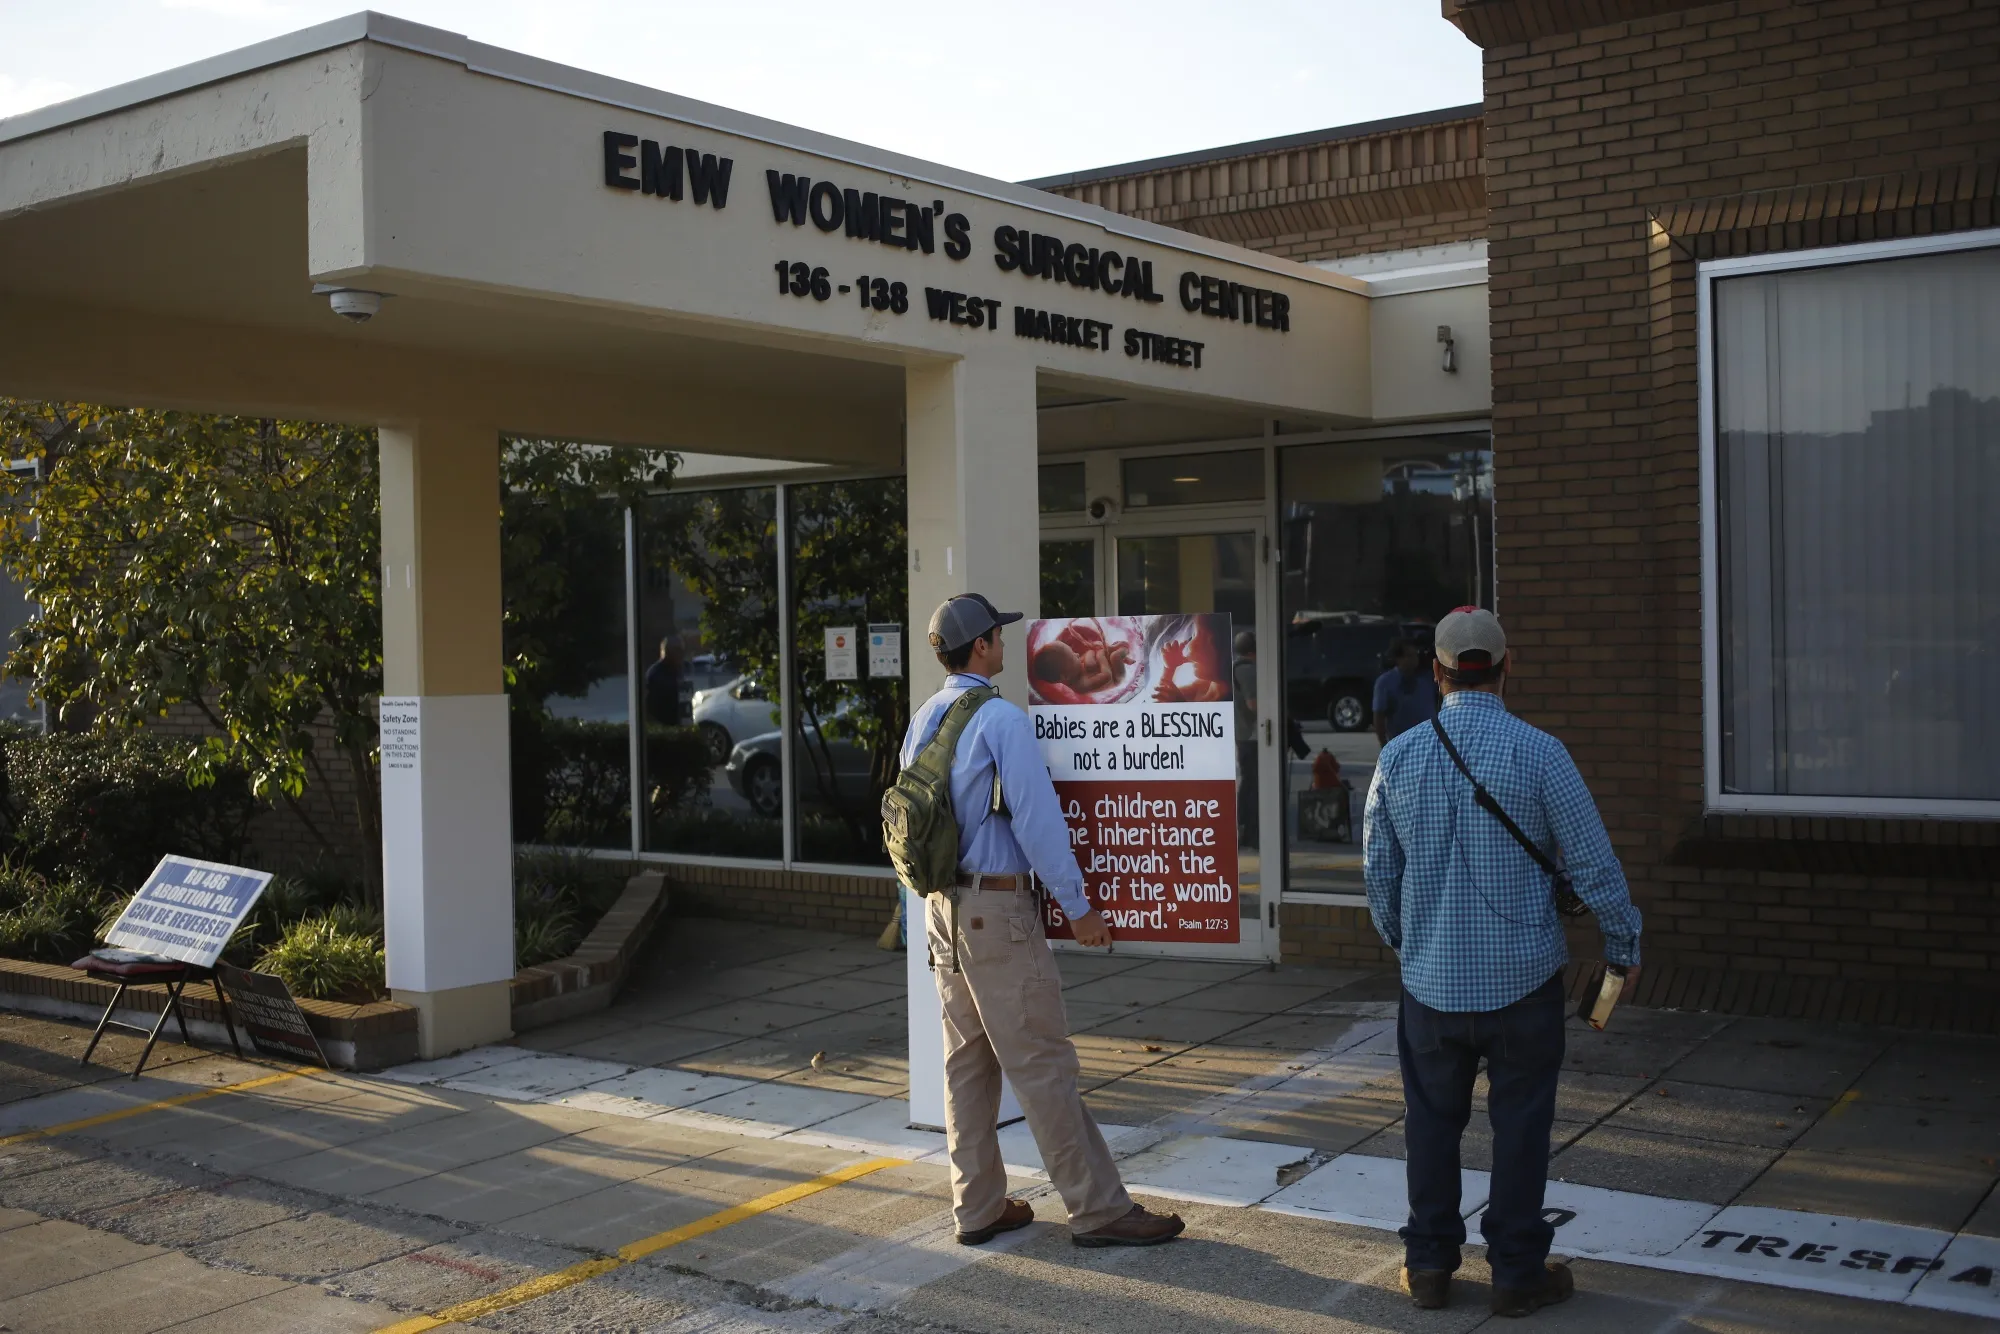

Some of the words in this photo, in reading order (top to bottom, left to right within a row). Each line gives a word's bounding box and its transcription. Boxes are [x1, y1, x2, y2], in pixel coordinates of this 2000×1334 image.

[604, 130, 733, 209] EMW
[766, 169, 970, 260] WOMEN'S
[994, 225, 1164, 303] SURGICAL
[1179, 271, 1291, 332] CENTER
[775, 260, 831, 301] 136
[856, 275, 909, 315] 138
[925, 286, 1002, 331] WEST
[1014, 306, 1113, 352] MARKET
[1123, 328, 1205, 369] STREET
[382, 714, 401, 724] Safety
[402, 714, 418, 724] Zone
[1035, 713, 1087, 739] Babies
[1093, 720, 1120, 739] are
[1126, 719, 1135, 738] a
[1141, 711, 1223, 738] BLESSING
[1073, 748, 1101, 770] not
[1108, 752, 1117, 770] a
[1123, 743, 1184, 770] burden!
[1094, 792, 1177, 819] children
[1184, 799, 1220, 818] are
[1097, 821, 1216, 847] inheritance
[1084, 848, 1170, 874] Jehovah;
[1179, 849, 1217, 874] the
[183, 869, 205, 886] RU
[202, 874, 231, 891] 486
[1098, 876, 1121, 901] of
[1129, 876, 1166, 901] the
[1173, 875, 1232, 903] womb
[150, 883, 212, 909] ABORTION
[209, 893, 239, 913] PILL
[128, 902, 157, 921] CAN
[154, 907, 173, 925] BE
[168, 911, 232, 938] REVERSED
[1046, 903, 1063, 927] is
[1100, 902, 1178, 929] eward.”
[1178, 918, 1202, 930] Psalm
[1205, 918, 1229, 930] 127:3
